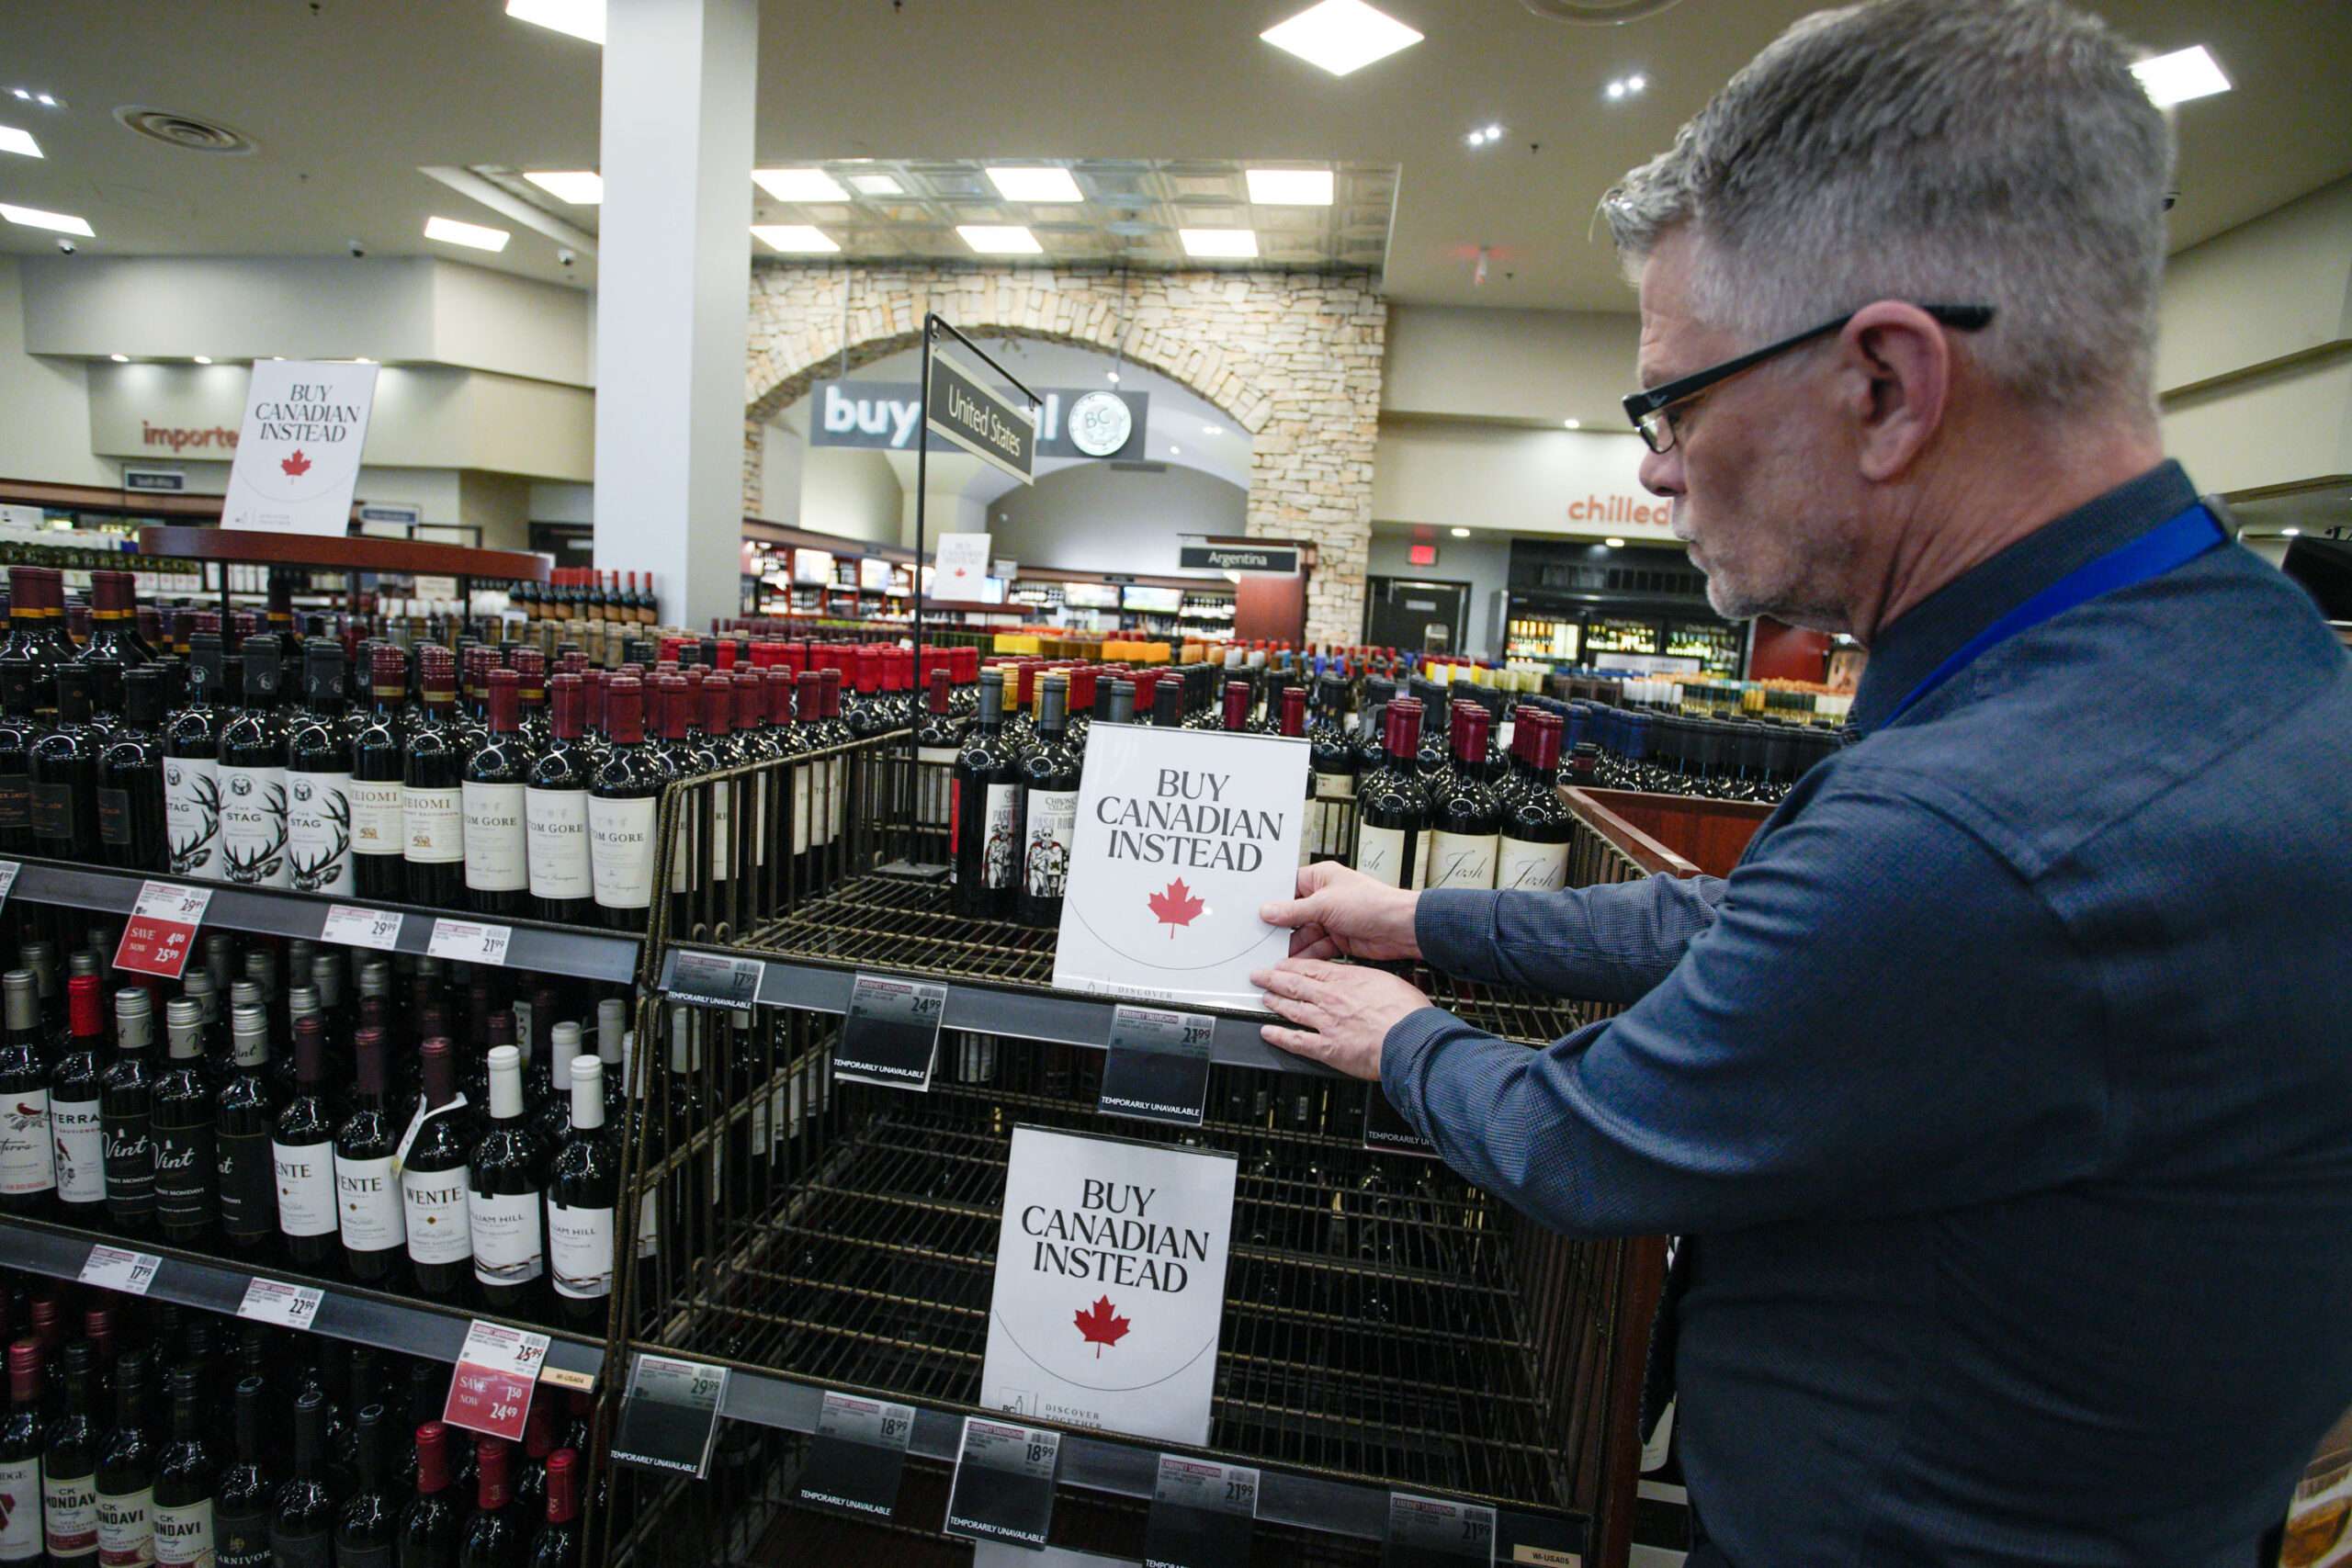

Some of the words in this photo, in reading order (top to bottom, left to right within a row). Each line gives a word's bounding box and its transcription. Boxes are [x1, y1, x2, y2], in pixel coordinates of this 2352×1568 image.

[290, 384, 332, 402] BUY
[255, 402, 360, 423] CANADIAN
[824, 386, 921, 447] buy
[947, 384, 989, 437] United
[989, 415, 1021, 457] States
[142, 420, 239, 453] importe
[260, 423, 346, 443] INSTEAD
[1568, 494, 1673, 525] chilled
[1208, 551, 1268, 568] Argentina
[1156, 769, 1230, 802] BUY
[228, 813, 262, 822] STAG
[290, 818, 322, 829] STAG
[482, 817, 517, 827] GORE
[1096, 795, 1284, 841] CANADIAN
[548, 823, 583, 834] GORE
[608, 832, 644, 842] GORE
[1107, 829, 1262, 873] INSTEAD
[130, 928, 155, 941] SAVE
[669, 991, 709, 1003] TEMPORARILY
[710, 997, 752, 1010] UNAVAILABLE
[833, 1058, 879, 1072] TEMPORARILY
[879, 1066, 925, 1078] UNAVAILABLE
[1102, 1096, 1150, 1110] TEMPORARILY
[1150, 1103, 1201, 1116] UNAVAILABLE
[1368, 1131, 1419, 1145] TEMPORARILY
[276, 1160, 311, 1178] ENTE
[406, 1186, 463, 1205] WENTE
[1080, 1178, 1156, 1216] BUY
[499, 1213, 524, 1224] HILL
[1022, 1205, 1210, 1262] CANADIAN
[1033, 1241, 1189, 1293] INSTEAD
[459, 1376, 488, 1393] SAVE
[459, 1394, 479, 1406] NOW
[1046, 1404, 1100, 1419] DISCOVER
[610, 1450, 654, 1465] TEMPORARILY
[653, 1457, 698, 1473] UNAVAILABLE
[46, 1493, 96, 1508] MONDAV
[102, 1503, 117, 1511] CK
[800, 1489, 845, 1505] TEMPORARILY
[846, 1499, 891, 1516] UNAVAILABLE
[96, 1509, 143, 1525] NDAVI
[160, 1514, 175, 1522] CK
[154, 1521, 200, 1537] NDAVI
[951, 1516, 997, 1534] TEMPORARILY
[998, 1528, 1046, 1544] UNAVAILABLE
[217, 1551, 272, 1565] ARNIVOR
